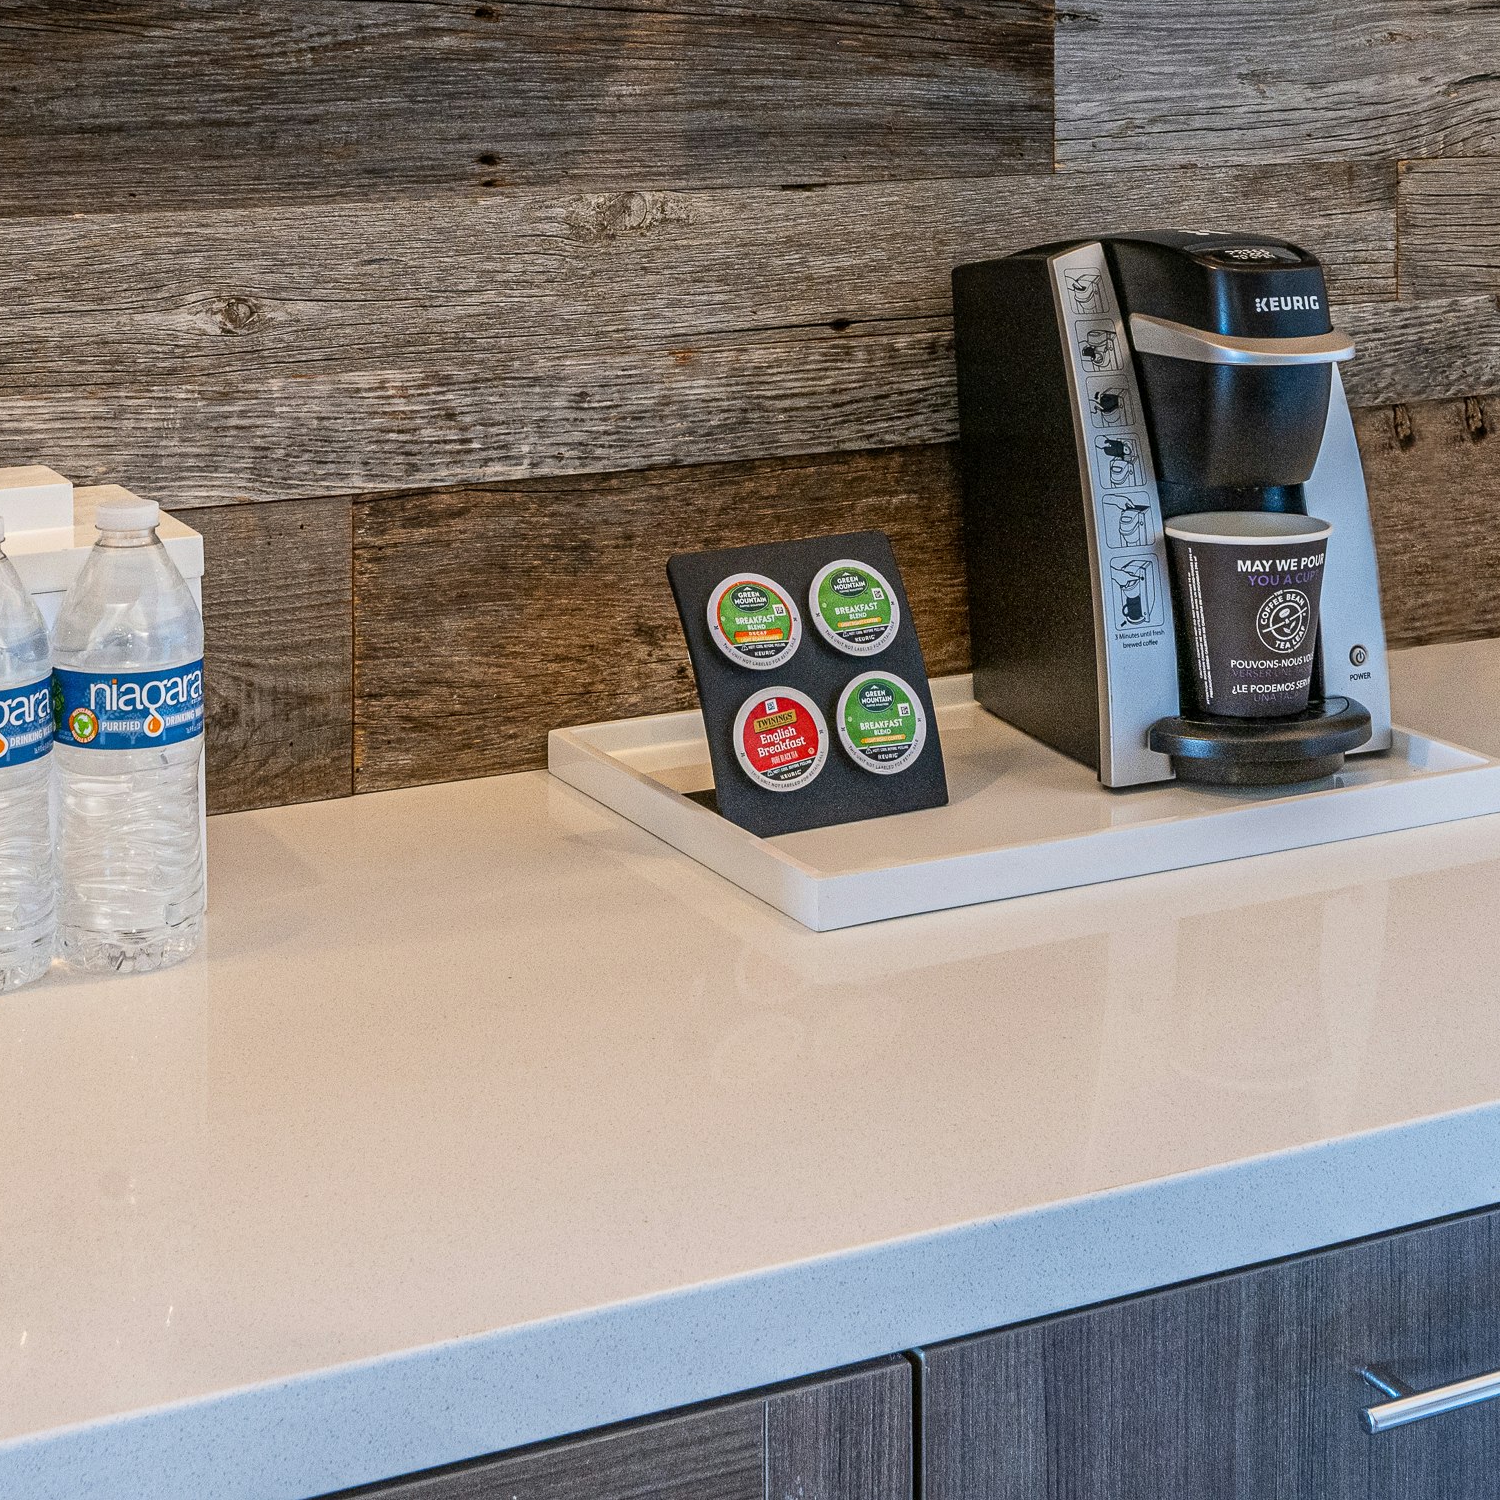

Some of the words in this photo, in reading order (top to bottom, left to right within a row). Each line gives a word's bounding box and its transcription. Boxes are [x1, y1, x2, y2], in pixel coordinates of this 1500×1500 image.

[1255, 295, 1320, 313] KEURIG
[1238, 560, 1272, 572] MAY
[1276, 558, 1298, 571] WE
[1300, 553, 1324, 569] POUR
[834, 581, 866, 590] MOUNTAIN
[837, 576, 859, 584] GREEN
[1248, 574, 1280, 586] YOU
[1284, 574, 1292, 584] A
[734, 596, 767, 604] MOUNTAIN
[834, 602, 878, 615] BREAKFAST
[1261, 595, 1283, 624] COFFEE
[1286, 594, 1305, 606] BEAN
[735, 615, 775, 624] BREAKFAST
[1275, 641, 1291, 649] TEA
[1292, 626, 1305, 645] LEAF
[1231, 658, 1302, 668] POUVONS-NOUS
[1350, 672, 1371, 681] POWER
[1250, 682, 1295, 693] PODEMOS
[90, 670, 202, 737] niagara
[861, 696, 892, 704] MOUNTAIN
[102, 721, 140, 732] PURIFIED
[166, 710, 194, 726] DRINKING
[757, 712, 793, 728] TWININGS
[860, 719, 903, 730] BREAKFAST
[10, 730, 43, 746] DRINKING
[760, 726, 797, 744] English
[757, 736, 806, 758] Breakfast
